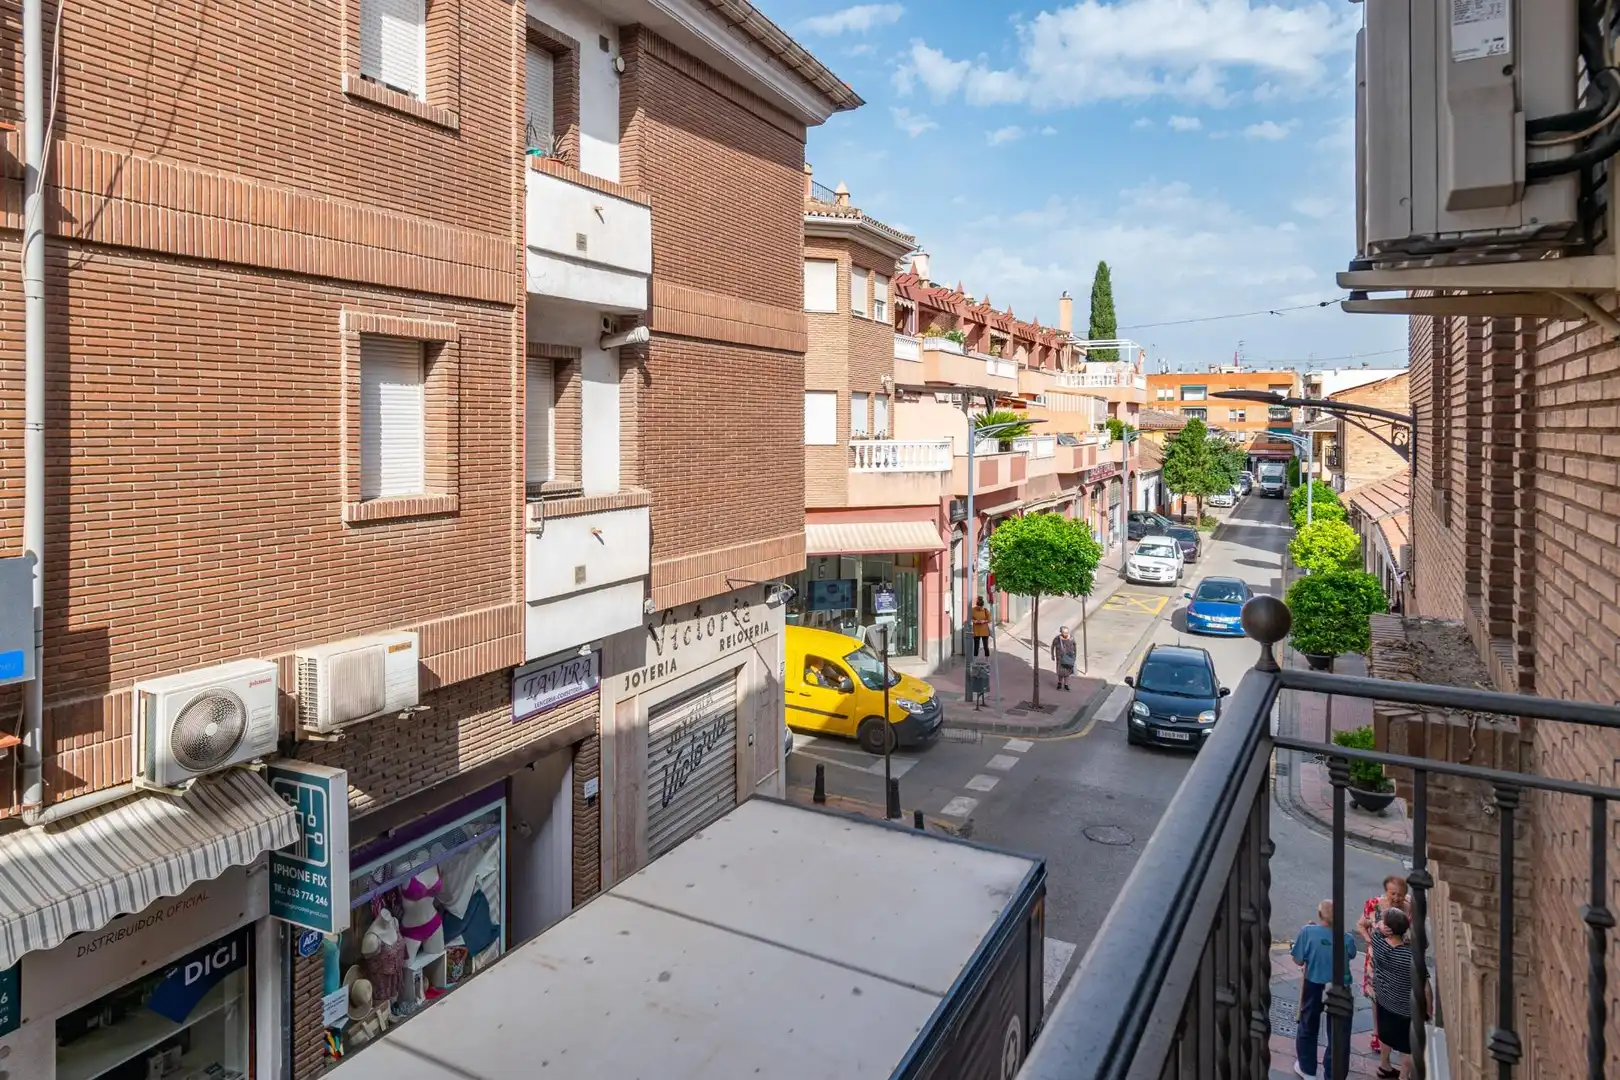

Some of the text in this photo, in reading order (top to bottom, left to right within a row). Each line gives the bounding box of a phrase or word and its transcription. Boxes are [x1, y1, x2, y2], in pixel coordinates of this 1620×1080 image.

[648, 598, 750, 656] Victoria
[719, 621, 769, 652] RELOJERIA
[523, 658, 592, 701] TAVIRA
[624, 658, 677, 691] JOYERIA
[273, 863, 328, 887] IPHONE FIX
[287, 887, 300, 898] 633
[301, 890, 314, 902] 774
[315, 895, 328, 906] 246
[76, 891, 211, 958] DISTRIBUIDOR OFICIAL
[184, 941, 237, 986] DIGI
